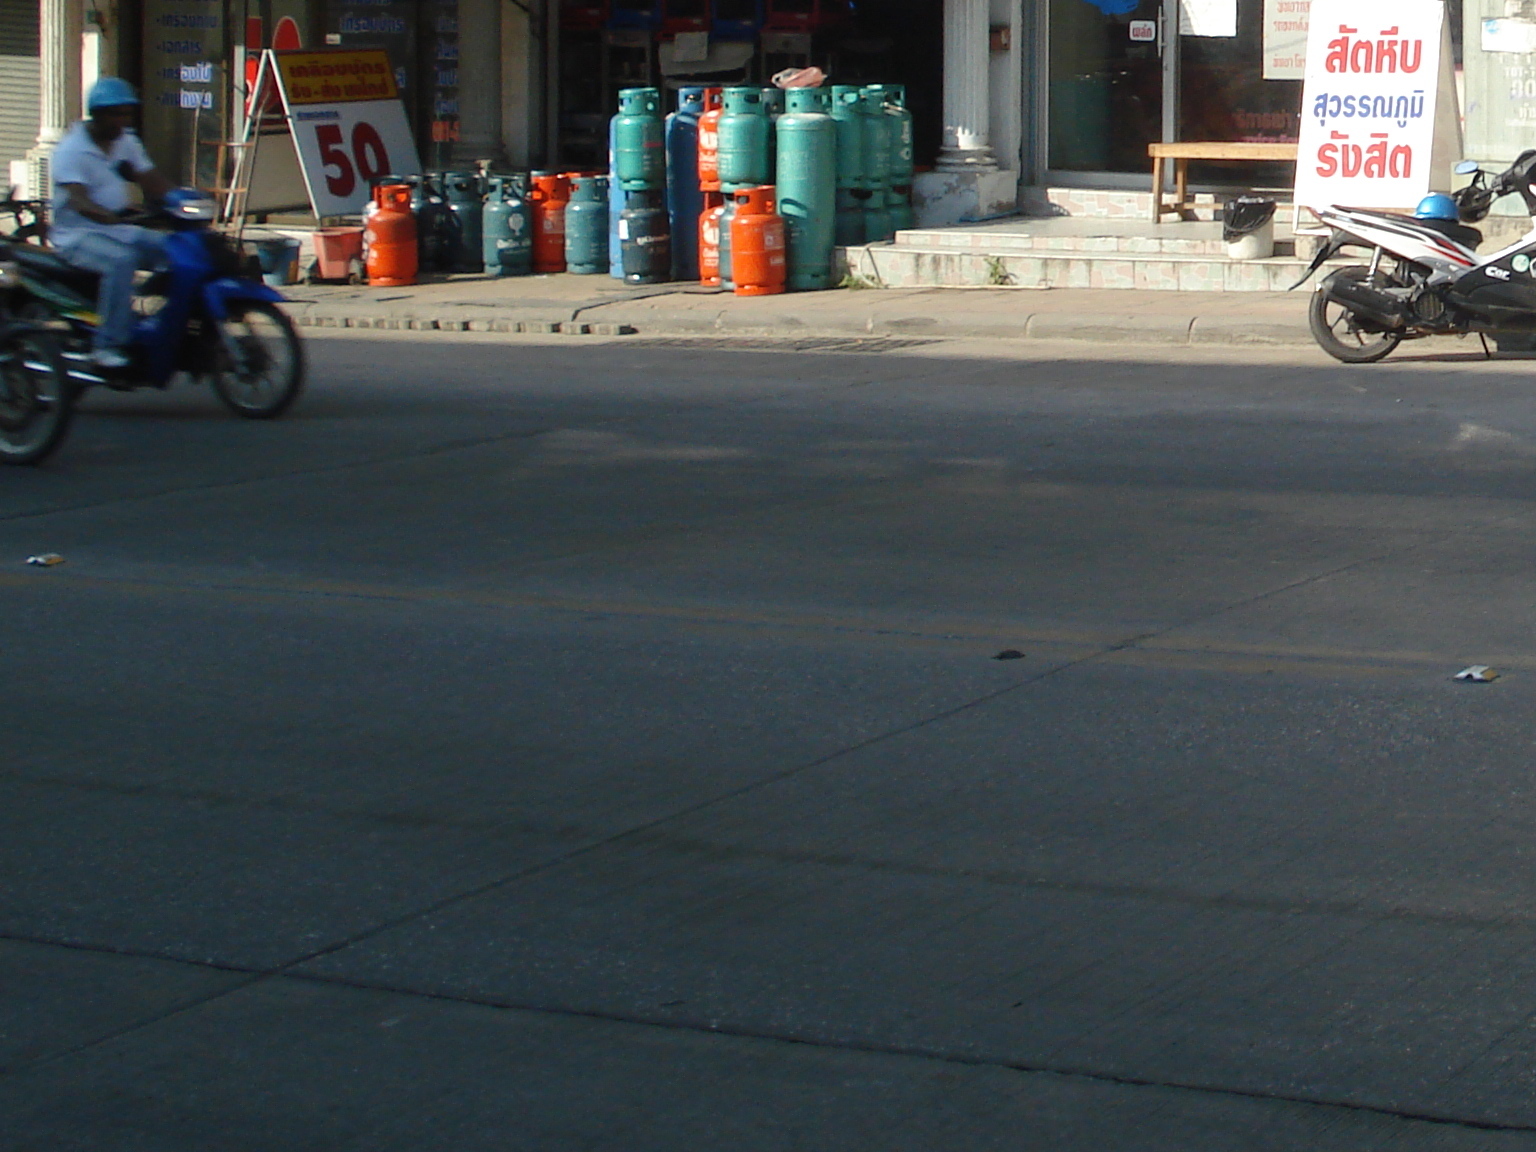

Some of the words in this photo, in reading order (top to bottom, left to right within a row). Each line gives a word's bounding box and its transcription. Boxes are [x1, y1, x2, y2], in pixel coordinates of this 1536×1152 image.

[1325, 24, 1422, 74] สัตหีบ
[1313, 90, 1425, 128] สุวรรณภูมิ
[314, 121, 391, 198] 50
[1316, 131, 1413, 179] รังสิต
